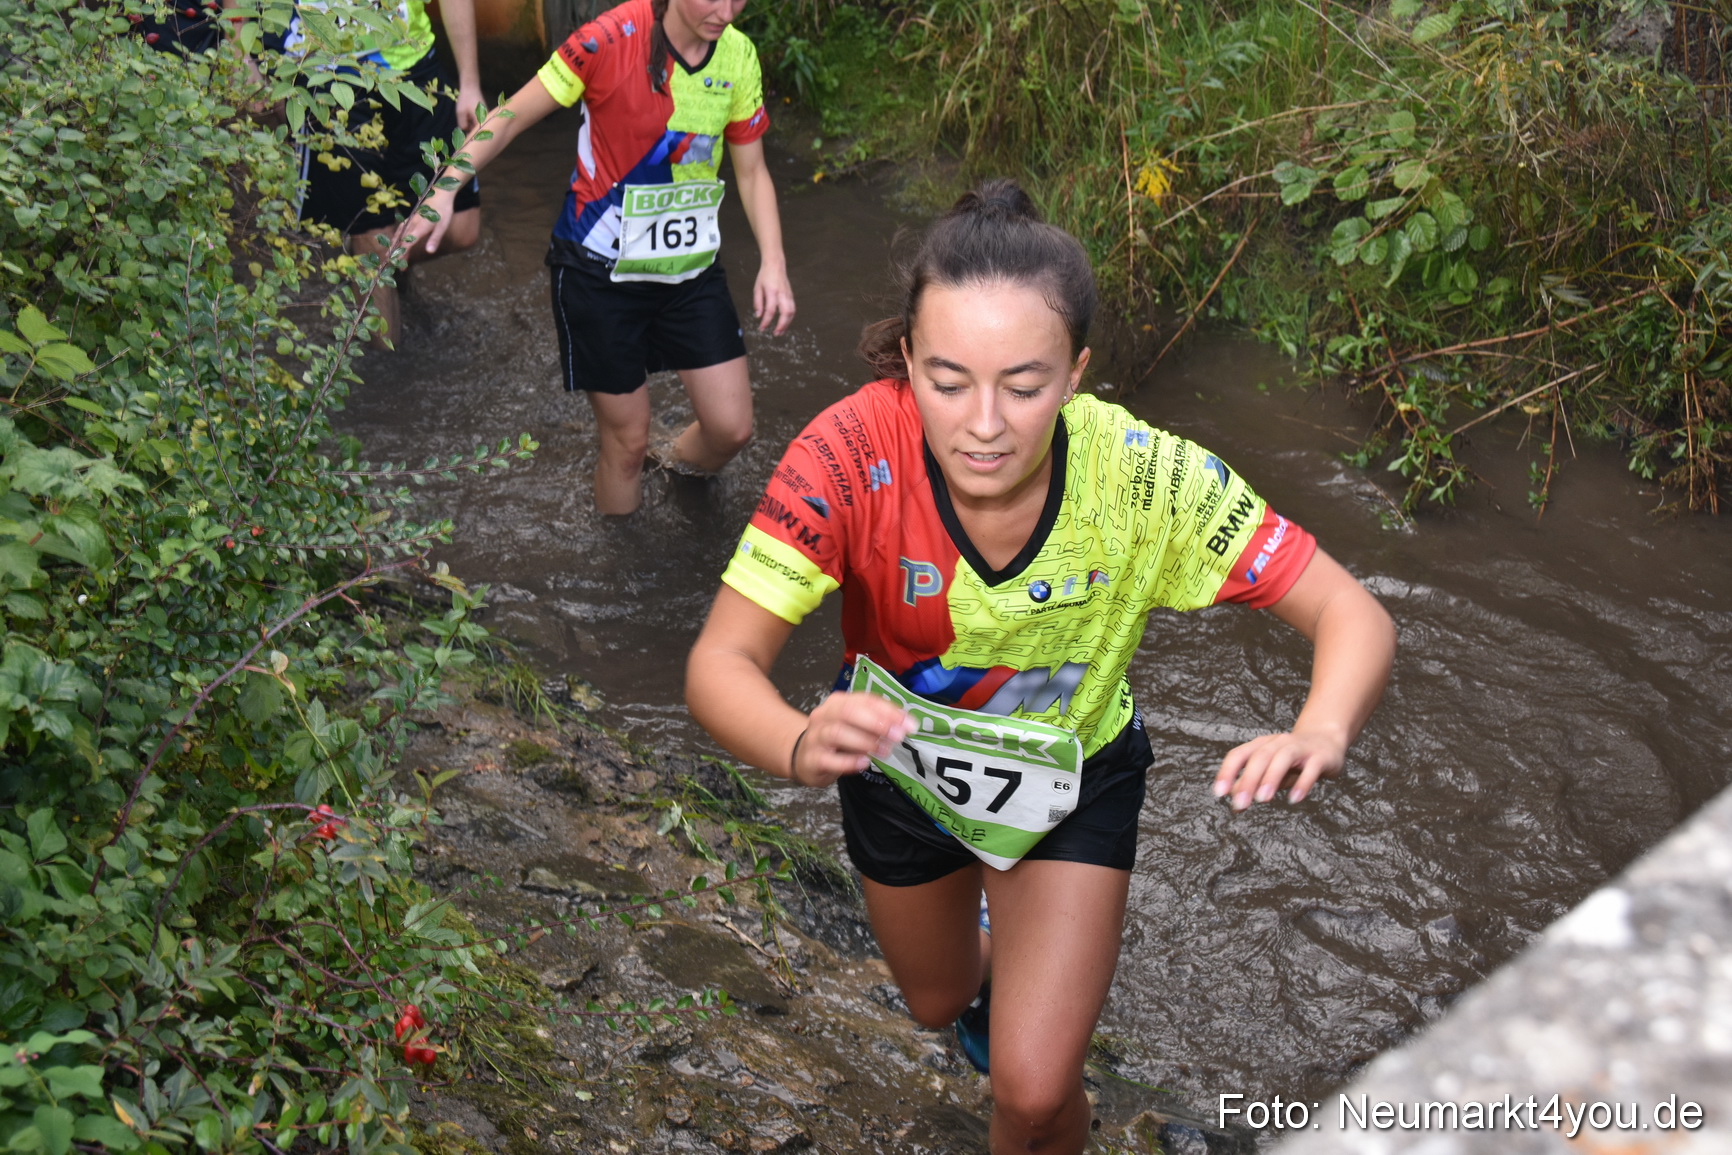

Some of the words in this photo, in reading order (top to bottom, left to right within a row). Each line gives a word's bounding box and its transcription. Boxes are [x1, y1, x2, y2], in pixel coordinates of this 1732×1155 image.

[634, 186, 712, 211] BOCK
[646, 216, 698, 251] 163
[813, 437, 854, 507] ABRAHAM
[1129, 452, 1147, 509] zerbock
[1206, 492, 1255, 556] BMW
[901, 741, 1022, 814] 157
[1053, 781, 1071, 792] E6
